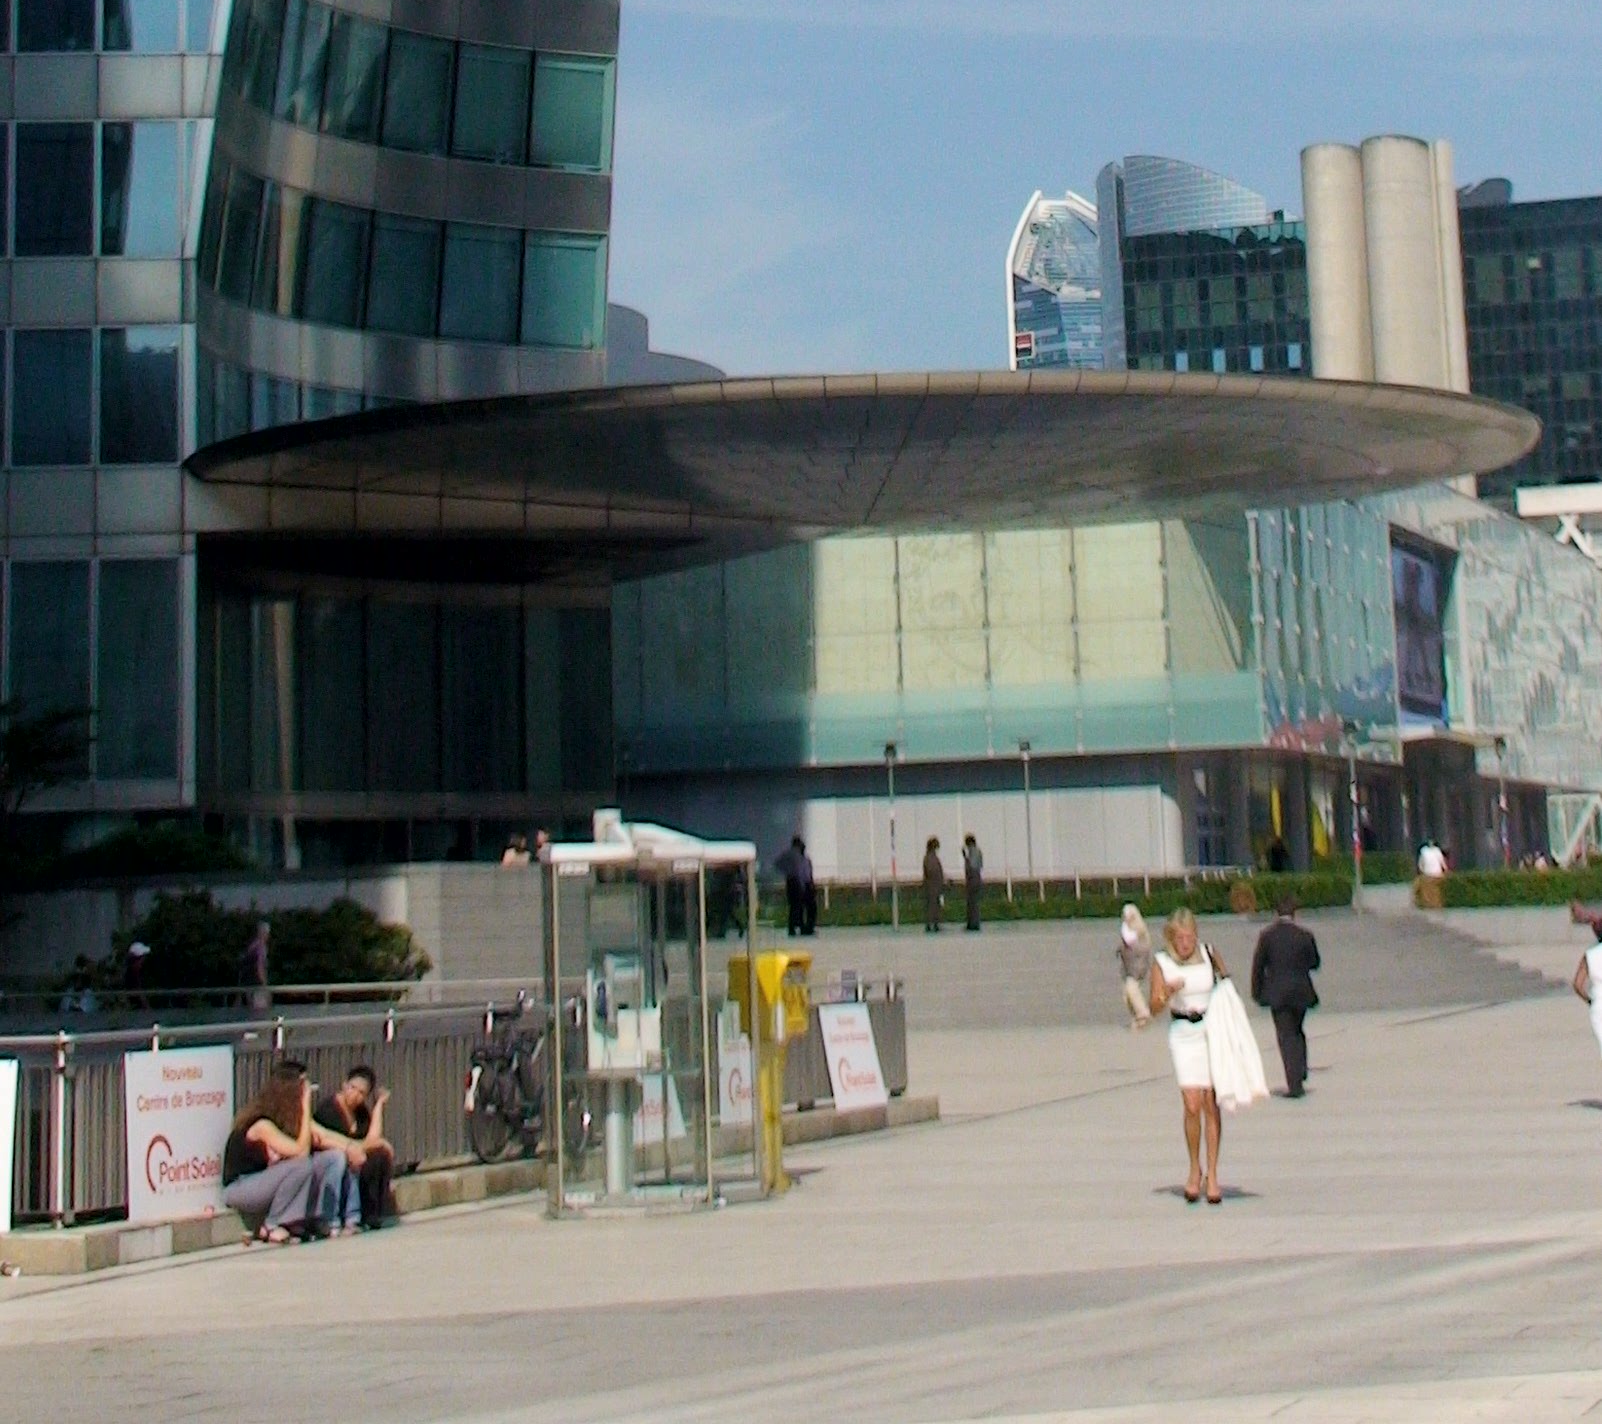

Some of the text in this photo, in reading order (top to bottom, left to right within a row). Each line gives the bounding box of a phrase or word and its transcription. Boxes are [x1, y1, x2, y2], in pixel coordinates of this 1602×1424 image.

[162, 1066, 203, 1080] Nouveau
[137, 1090, 226, 1111] Centre de Bronzage
